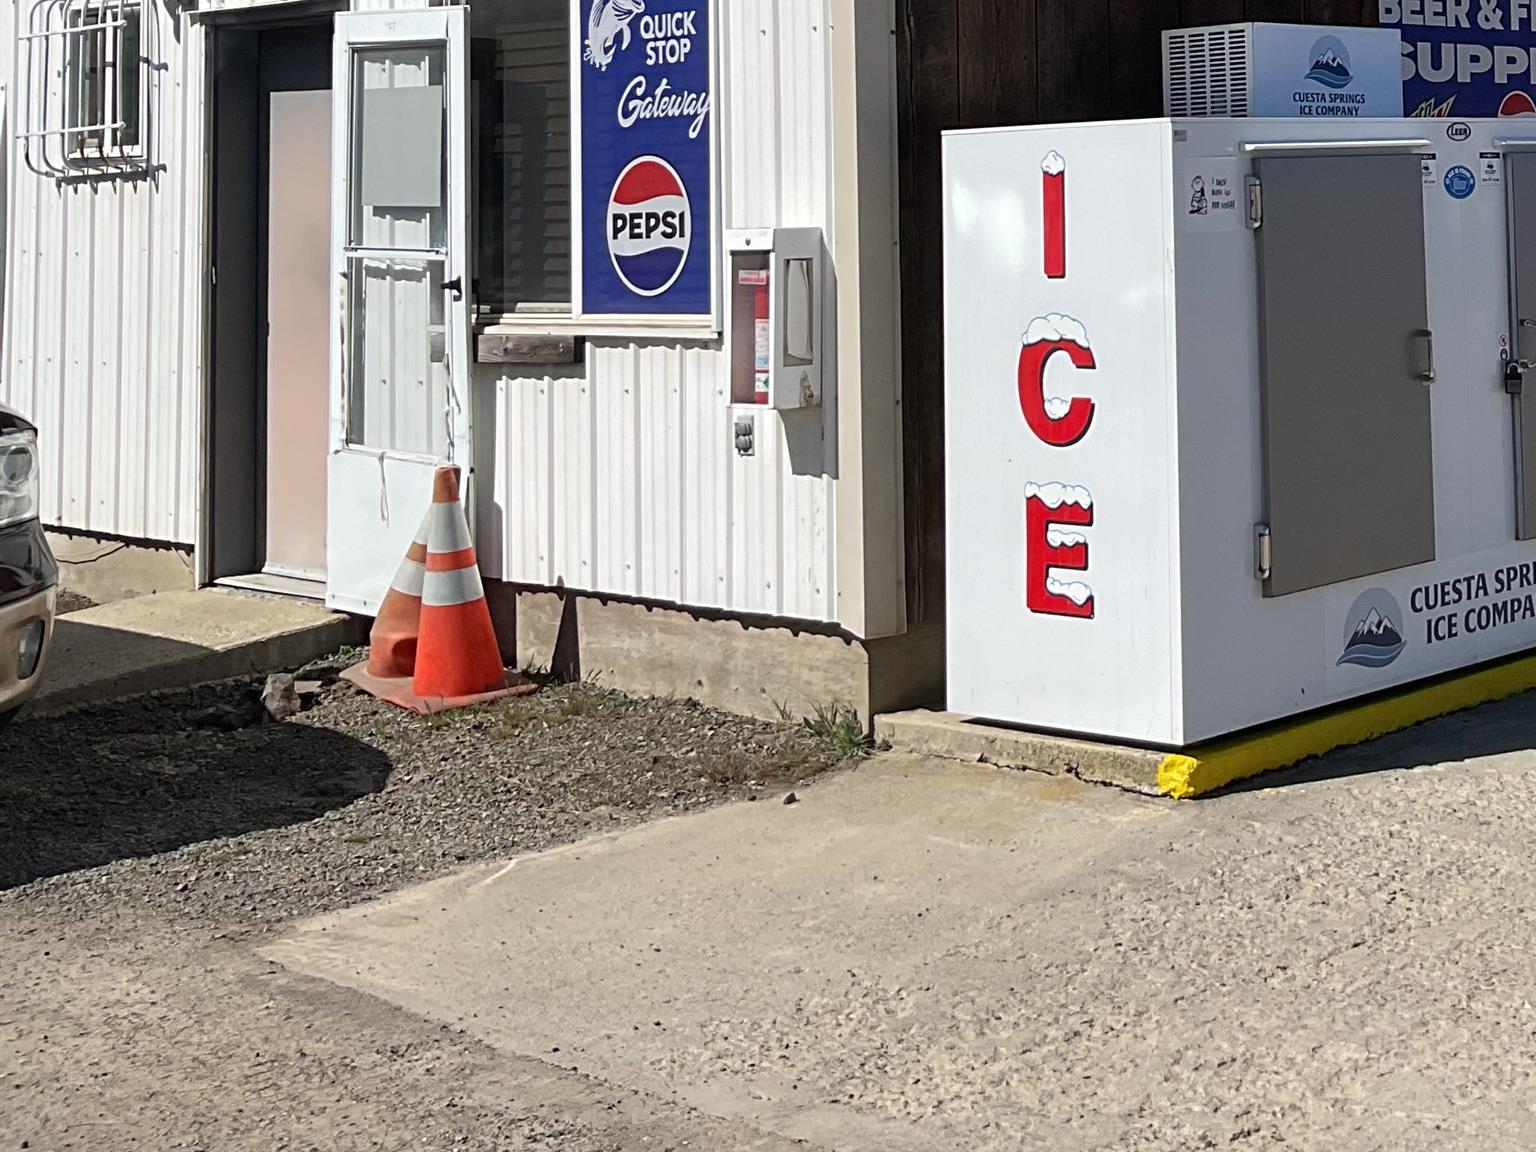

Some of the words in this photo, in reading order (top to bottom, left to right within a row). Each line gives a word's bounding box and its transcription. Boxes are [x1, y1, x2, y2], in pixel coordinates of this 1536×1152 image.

[640, 11, 697, 40] QUICK
[646, 38, 691, 65] STOP
[617, 75, 711, 139] Gateway
[1293, 92, 1326, 103] CUESTA
[1329, 93, 1366, 104] SPRINGS
[1300, 105, 1314, 115] ICE
[1315, 105, 1360, 116] COMPANY
[612, 210, 686, 240] PEPSI
[1017, 150, 1096, 620] ICE
[1411, 573, 1489, 614] CUESTA
[1426, 613, 1458, 644] ICE
